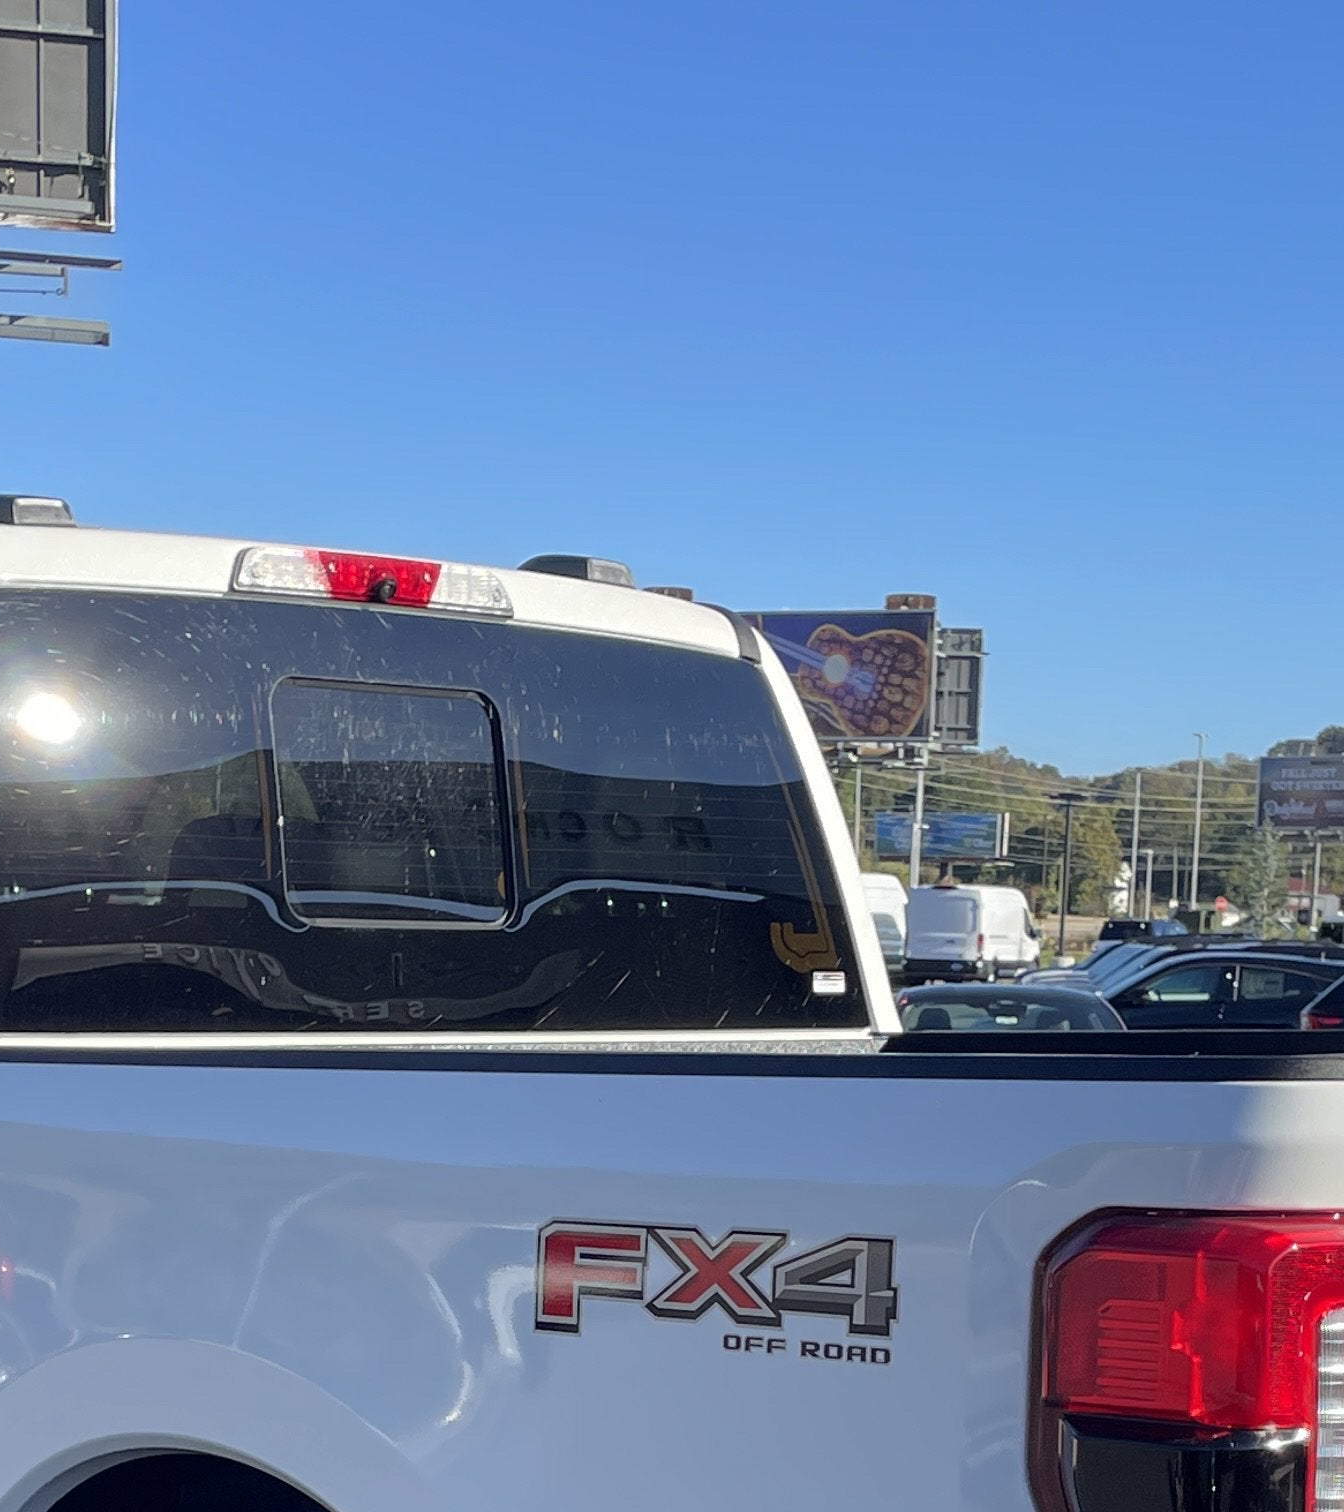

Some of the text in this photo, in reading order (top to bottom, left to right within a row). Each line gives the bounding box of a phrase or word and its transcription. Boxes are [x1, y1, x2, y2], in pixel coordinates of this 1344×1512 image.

[535, 1219, 899, 1336] FX4
[723, 1334, 893, 1366] OFF ROAD
